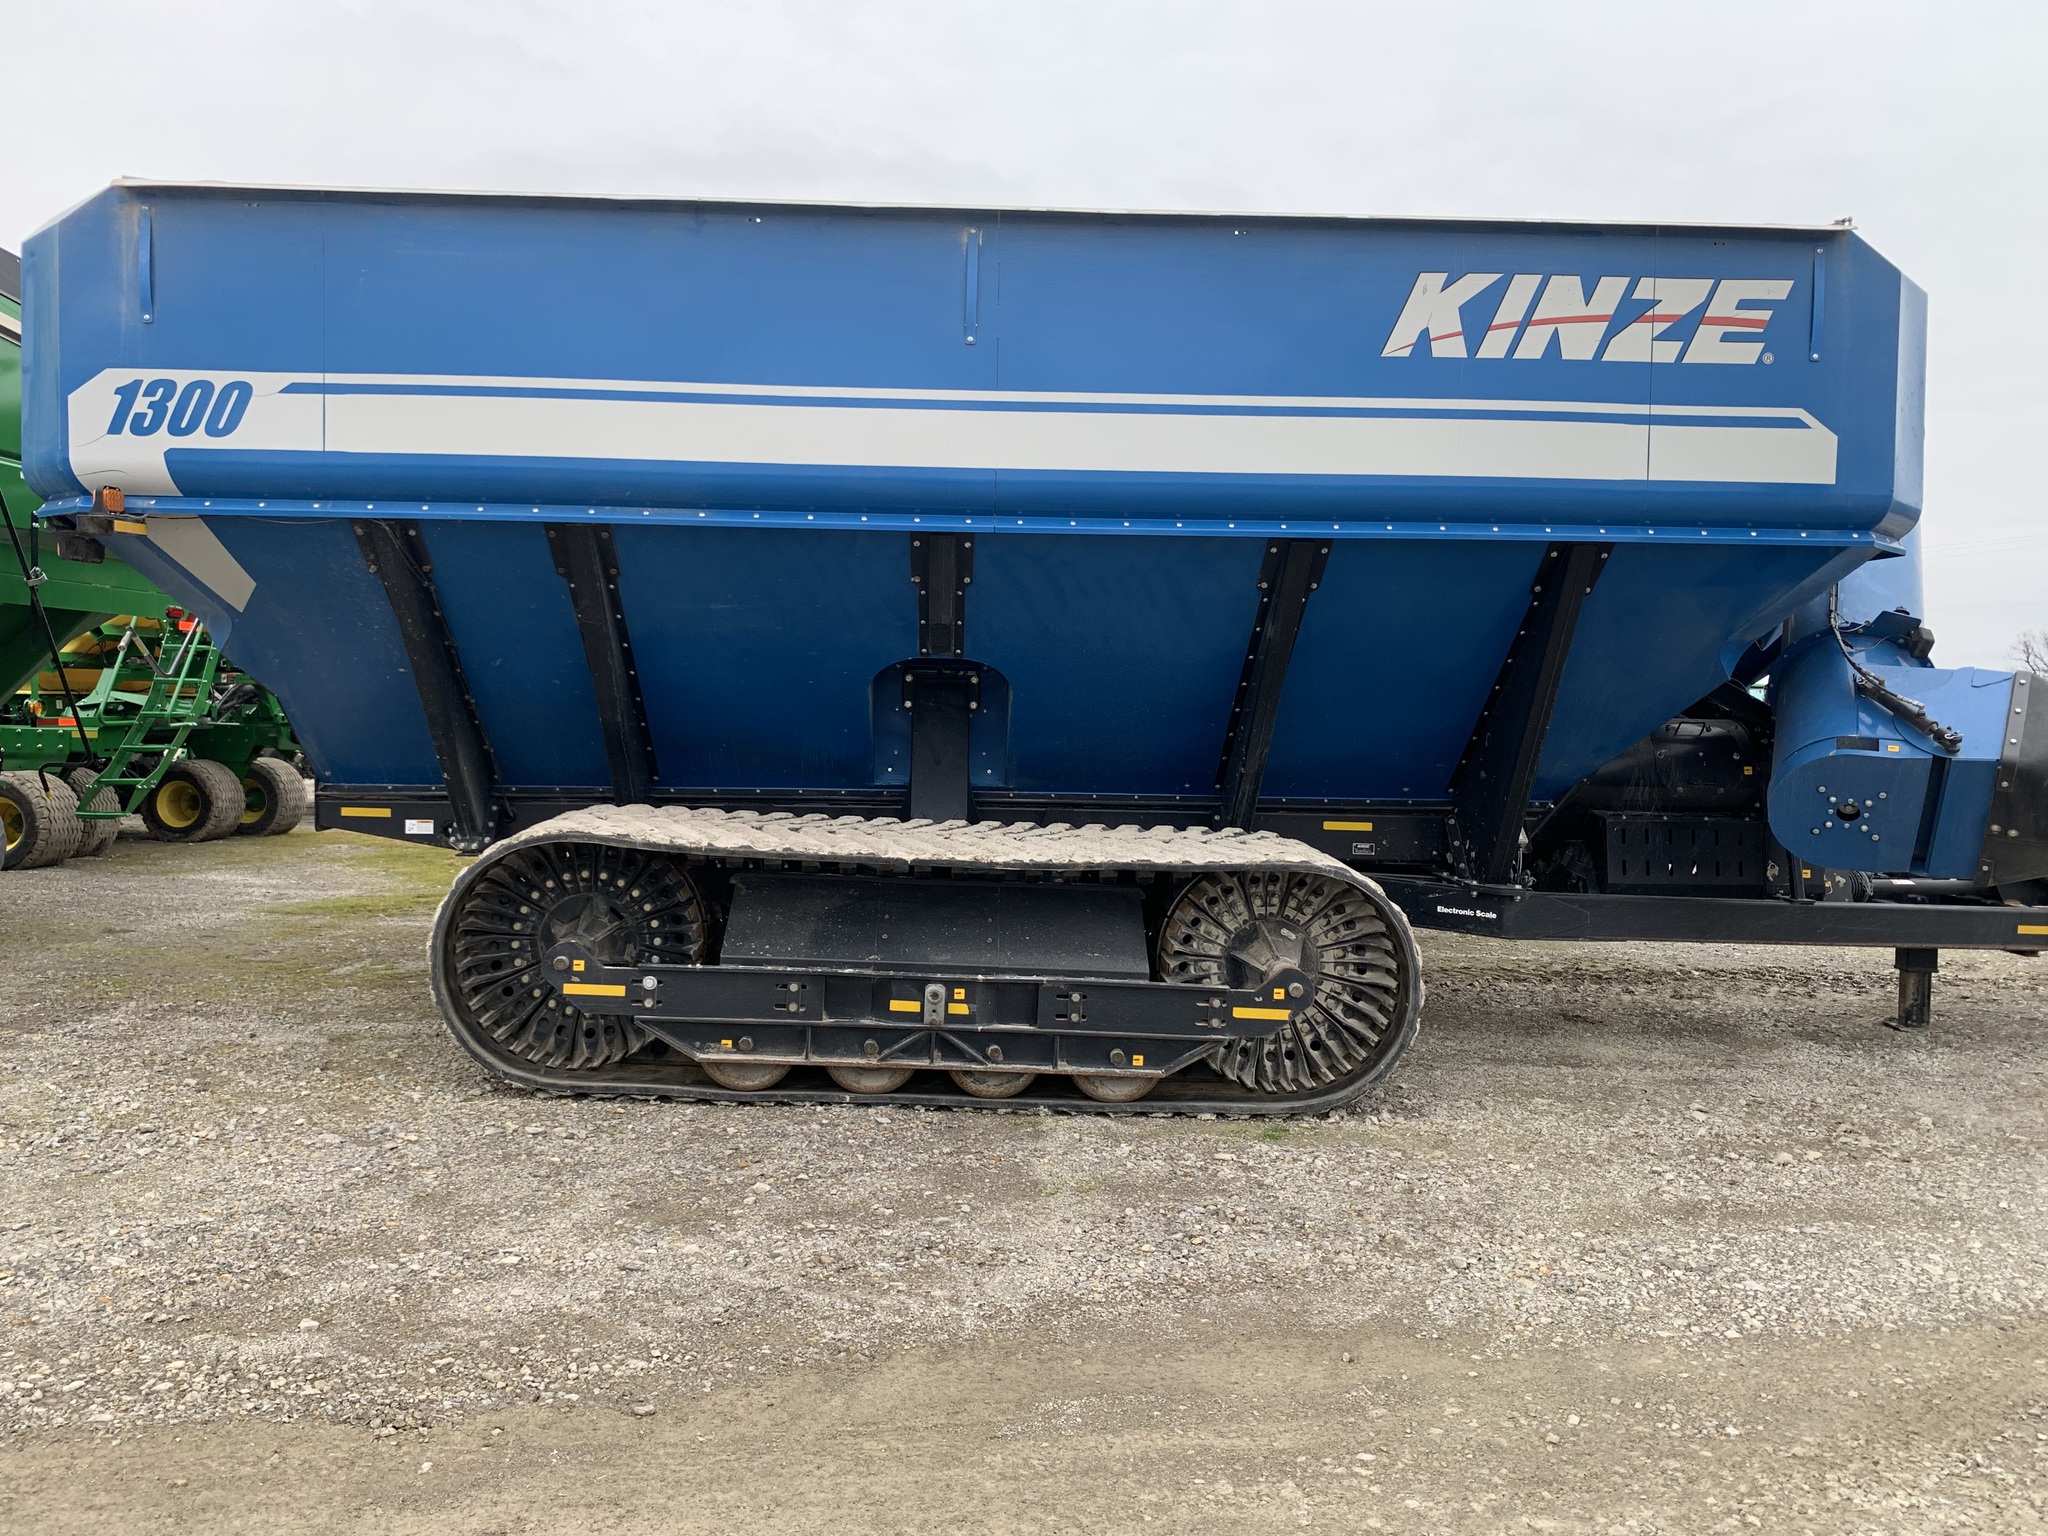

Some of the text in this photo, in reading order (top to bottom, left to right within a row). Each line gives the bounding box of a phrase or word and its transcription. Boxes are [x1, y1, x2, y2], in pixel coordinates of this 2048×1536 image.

[1380, 272, 1795, 364] KINZE
[106, 378, 254, 438] 1300
[1436, 905, 1497, 919] Electronic Scale
